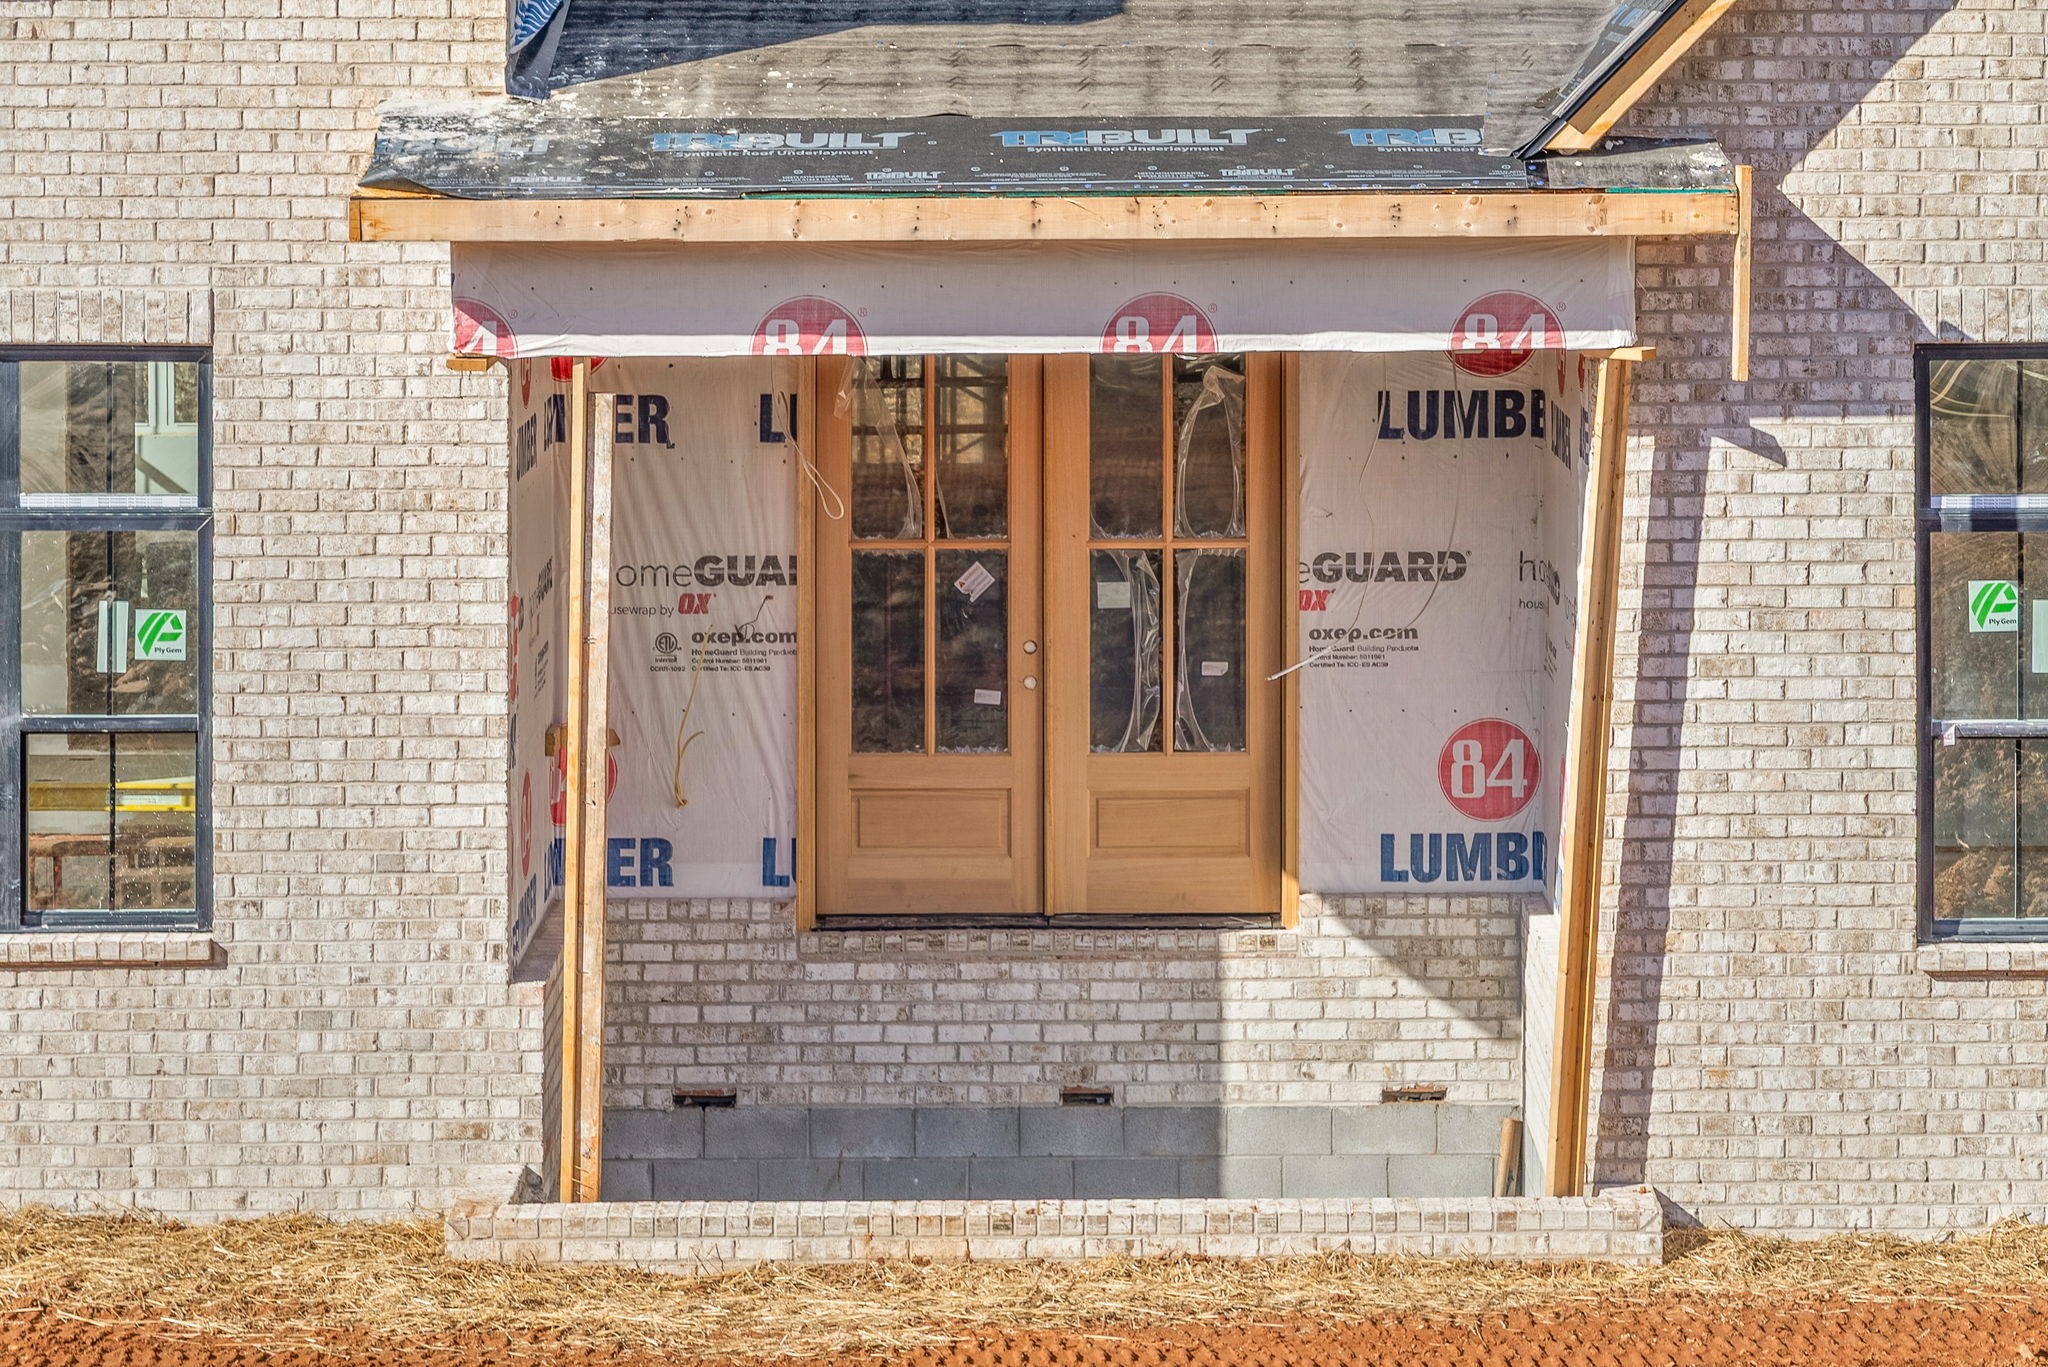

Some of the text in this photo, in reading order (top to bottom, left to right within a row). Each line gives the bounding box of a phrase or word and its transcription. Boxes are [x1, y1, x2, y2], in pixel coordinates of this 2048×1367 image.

[1460, 313, 1546, 350] 84
[660, 604, 674, 618] by
[678, 592, 712, 615] OX
[1988, 618, 2001, 626] Ply
[1308, 627, 1419, 643] oxep.com
[154, 646, 182, 654] Ply Gem
[1357, 645, 1385, 653] Building
[1451, 738, 1528, 799] 84
